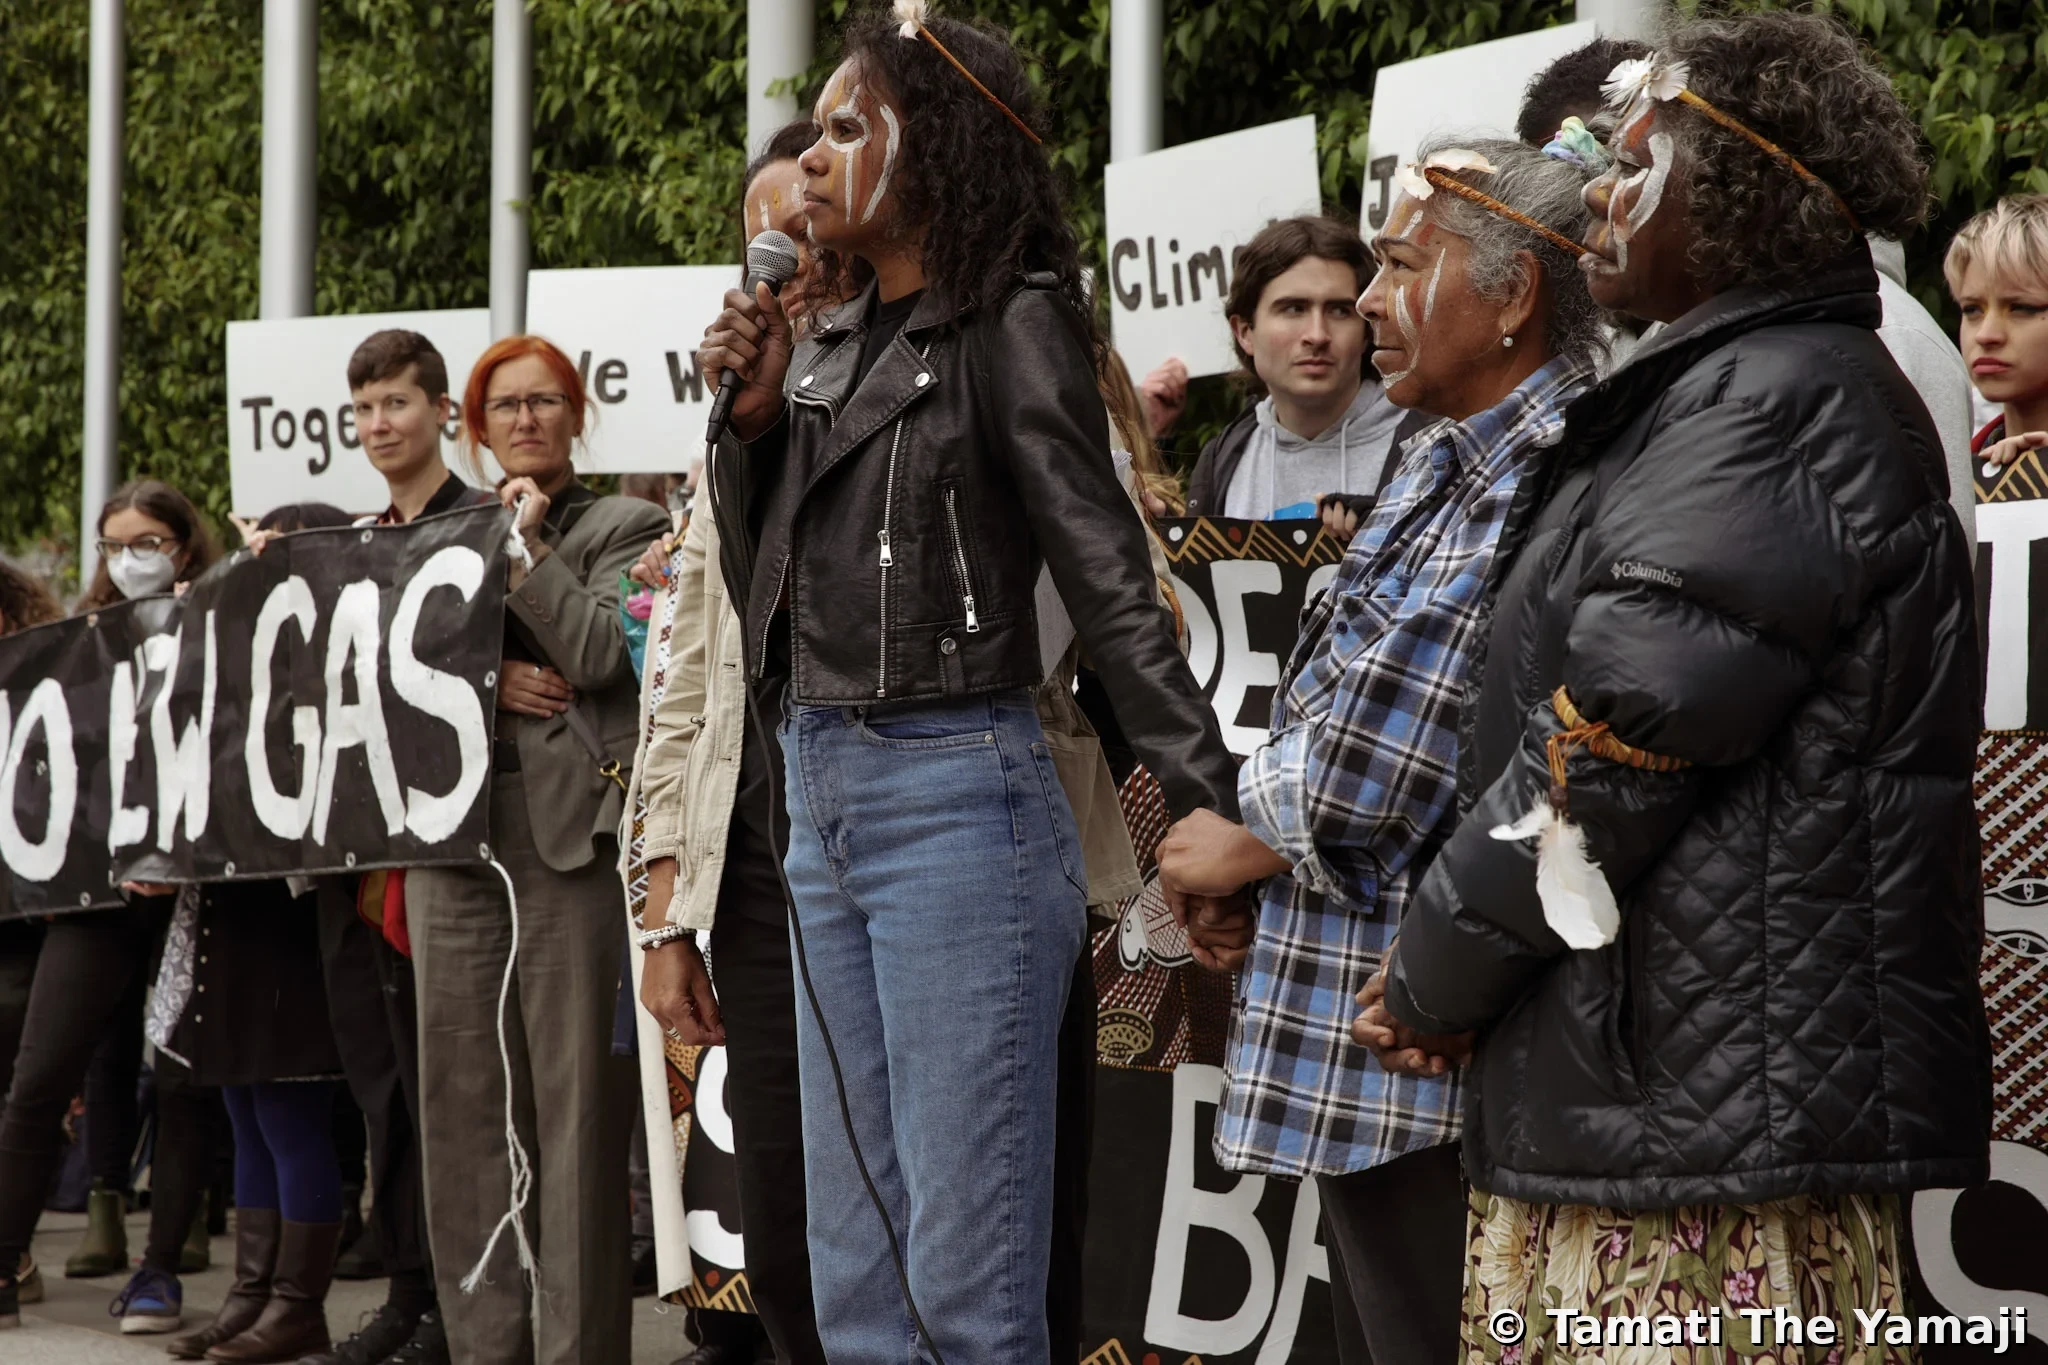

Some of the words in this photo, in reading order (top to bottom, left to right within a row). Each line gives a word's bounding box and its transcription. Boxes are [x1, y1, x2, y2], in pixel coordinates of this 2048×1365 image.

[1111, 230, 1262, 312] Clim
[241, 396, 463, 476] Togee
[1622, 561, 1683, 588] Columbia
[245, 545, 489, 846] GAS
